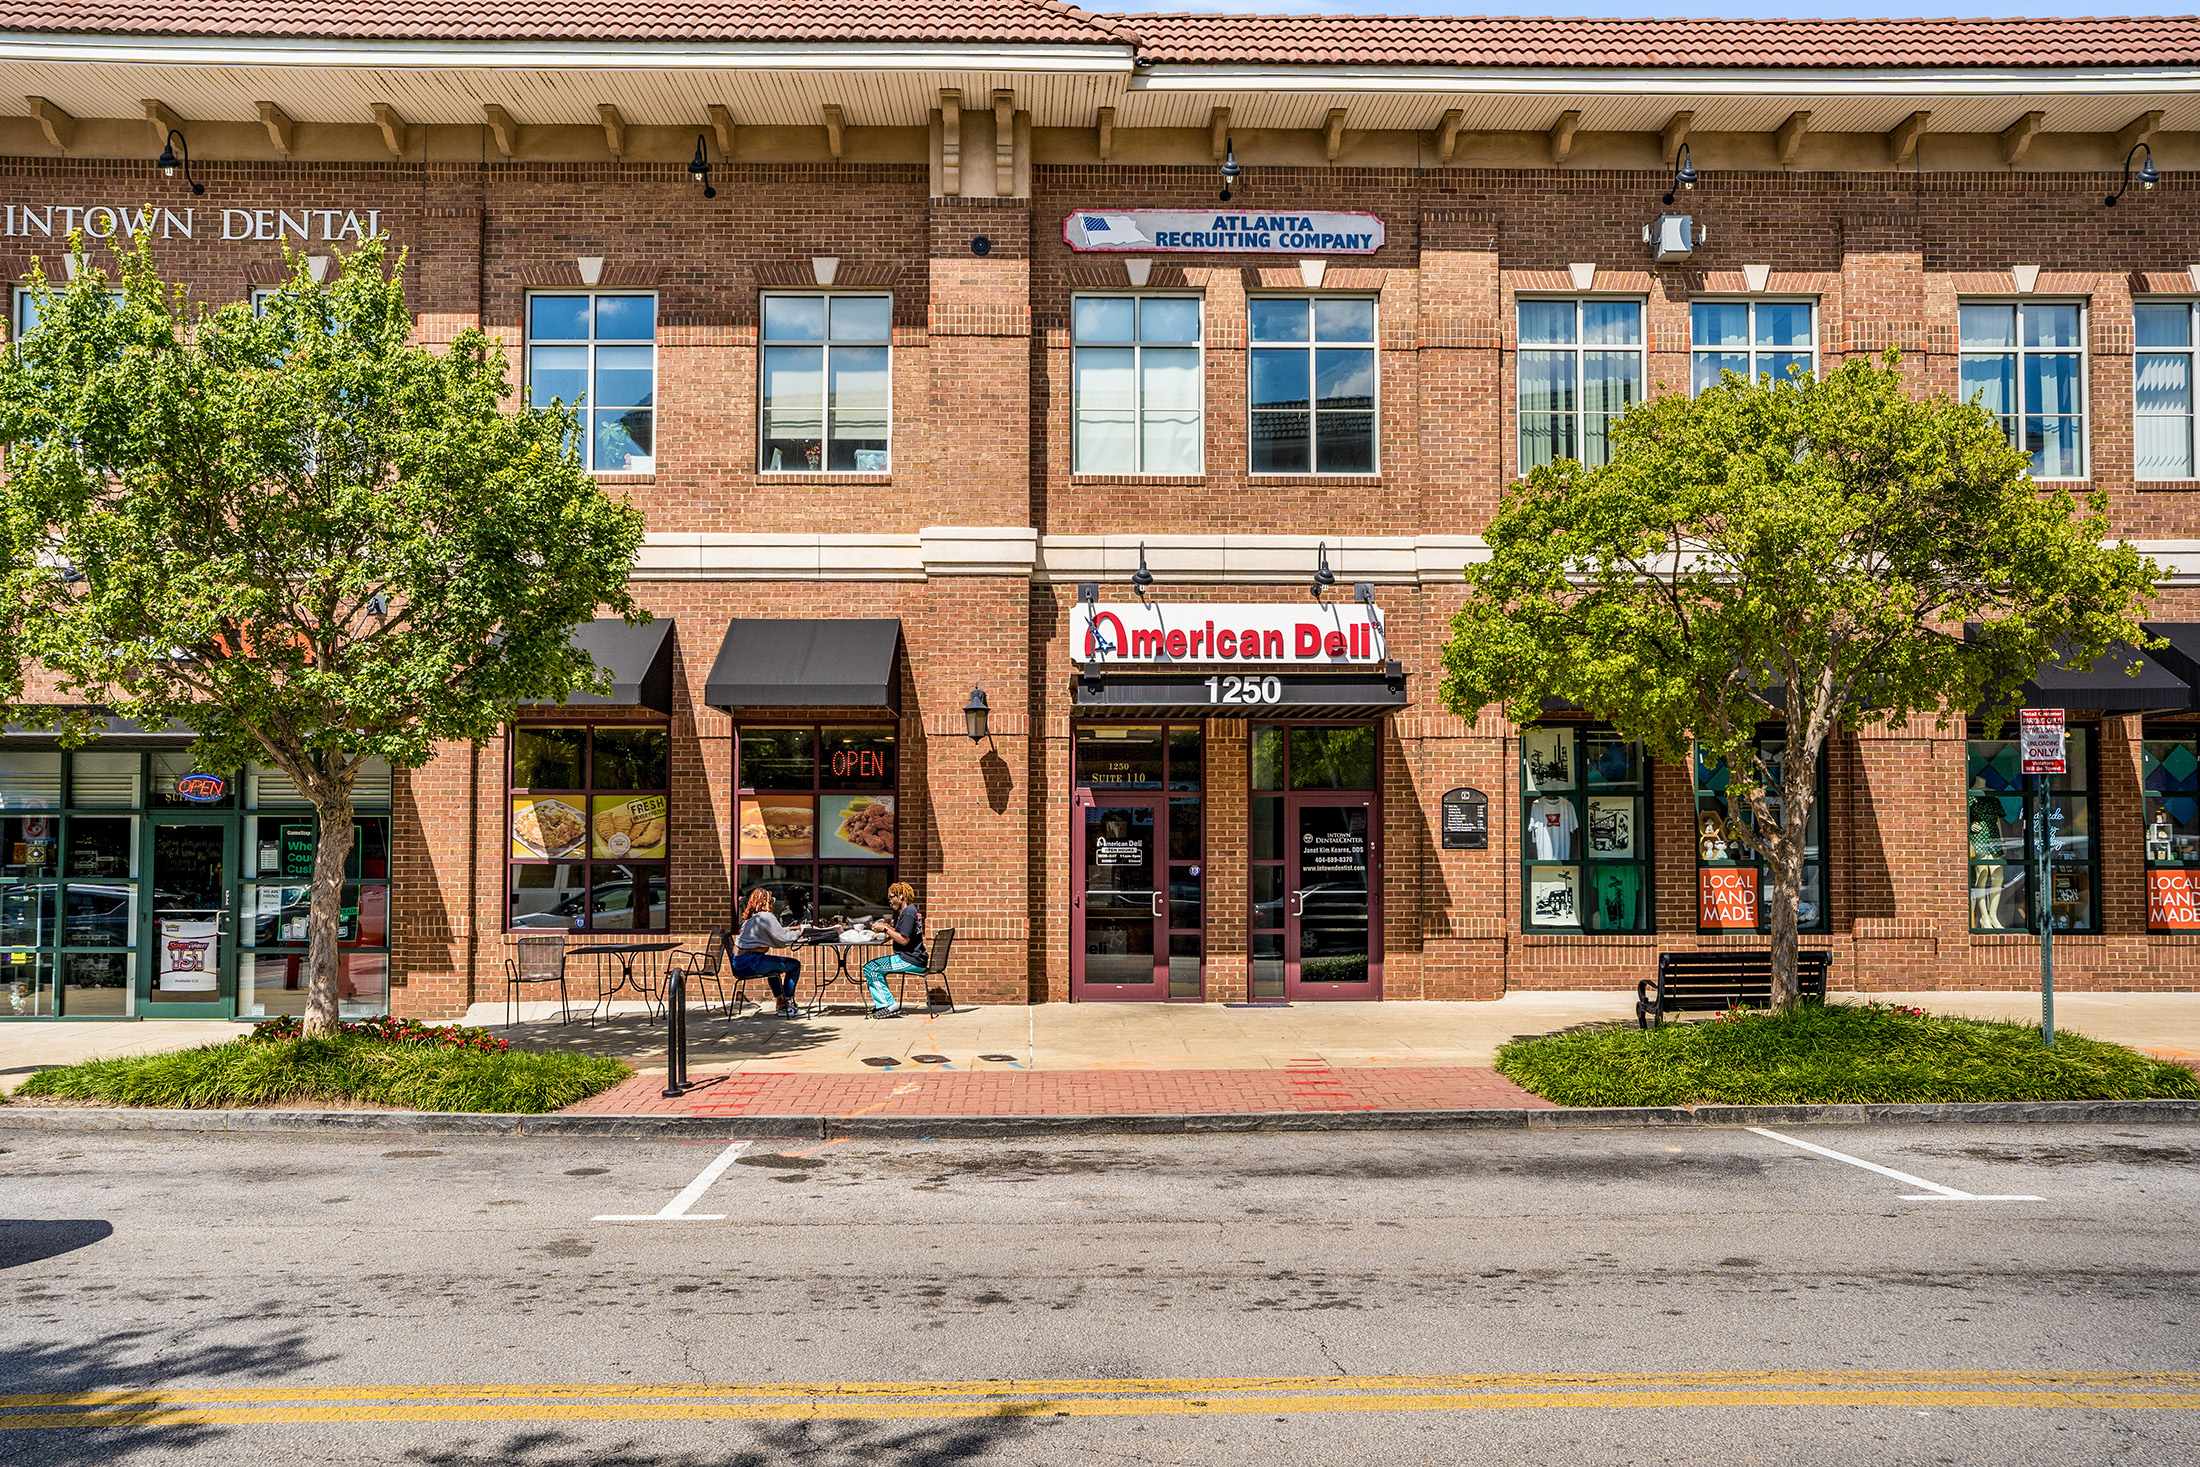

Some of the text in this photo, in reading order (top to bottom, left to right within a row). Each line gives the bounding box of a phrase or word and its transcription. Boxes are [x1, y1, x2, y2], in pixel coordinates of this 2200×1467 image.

[3, 204, 391, 241] INTOWN DENTAL
[1211, 215, 1314, 232] ATLANTA
[1155, 231, 1373, 249] RECRUITING COMPANY
[1084, 611, 1371, 659] American Deli
[1204, 676, 1282, 704] 1250
[2029, 748, 2059, 757] ONLY!
[832, 750, 884, 777] OPEN
[1108, 763, 1130, 771] 1250
[1091, 773, 1146, 783] SUITE 110
[178, 779, 224, 795] OPEN
[630, 797, 665, 815] FRESH
[287, 841, 312, 851] Whe
[1703, 875, 1753, 889] LOCAL
[2150, 876, 2200, 890] LOCAL
[1703, 890, 1756, 905] HAND
[2150, 891, 2200, 906] HAND
[1703, 906, 1755, 921] MADE
[2150, 908, 2200, 922] MADE
[171, 949, 204, 970] 151
